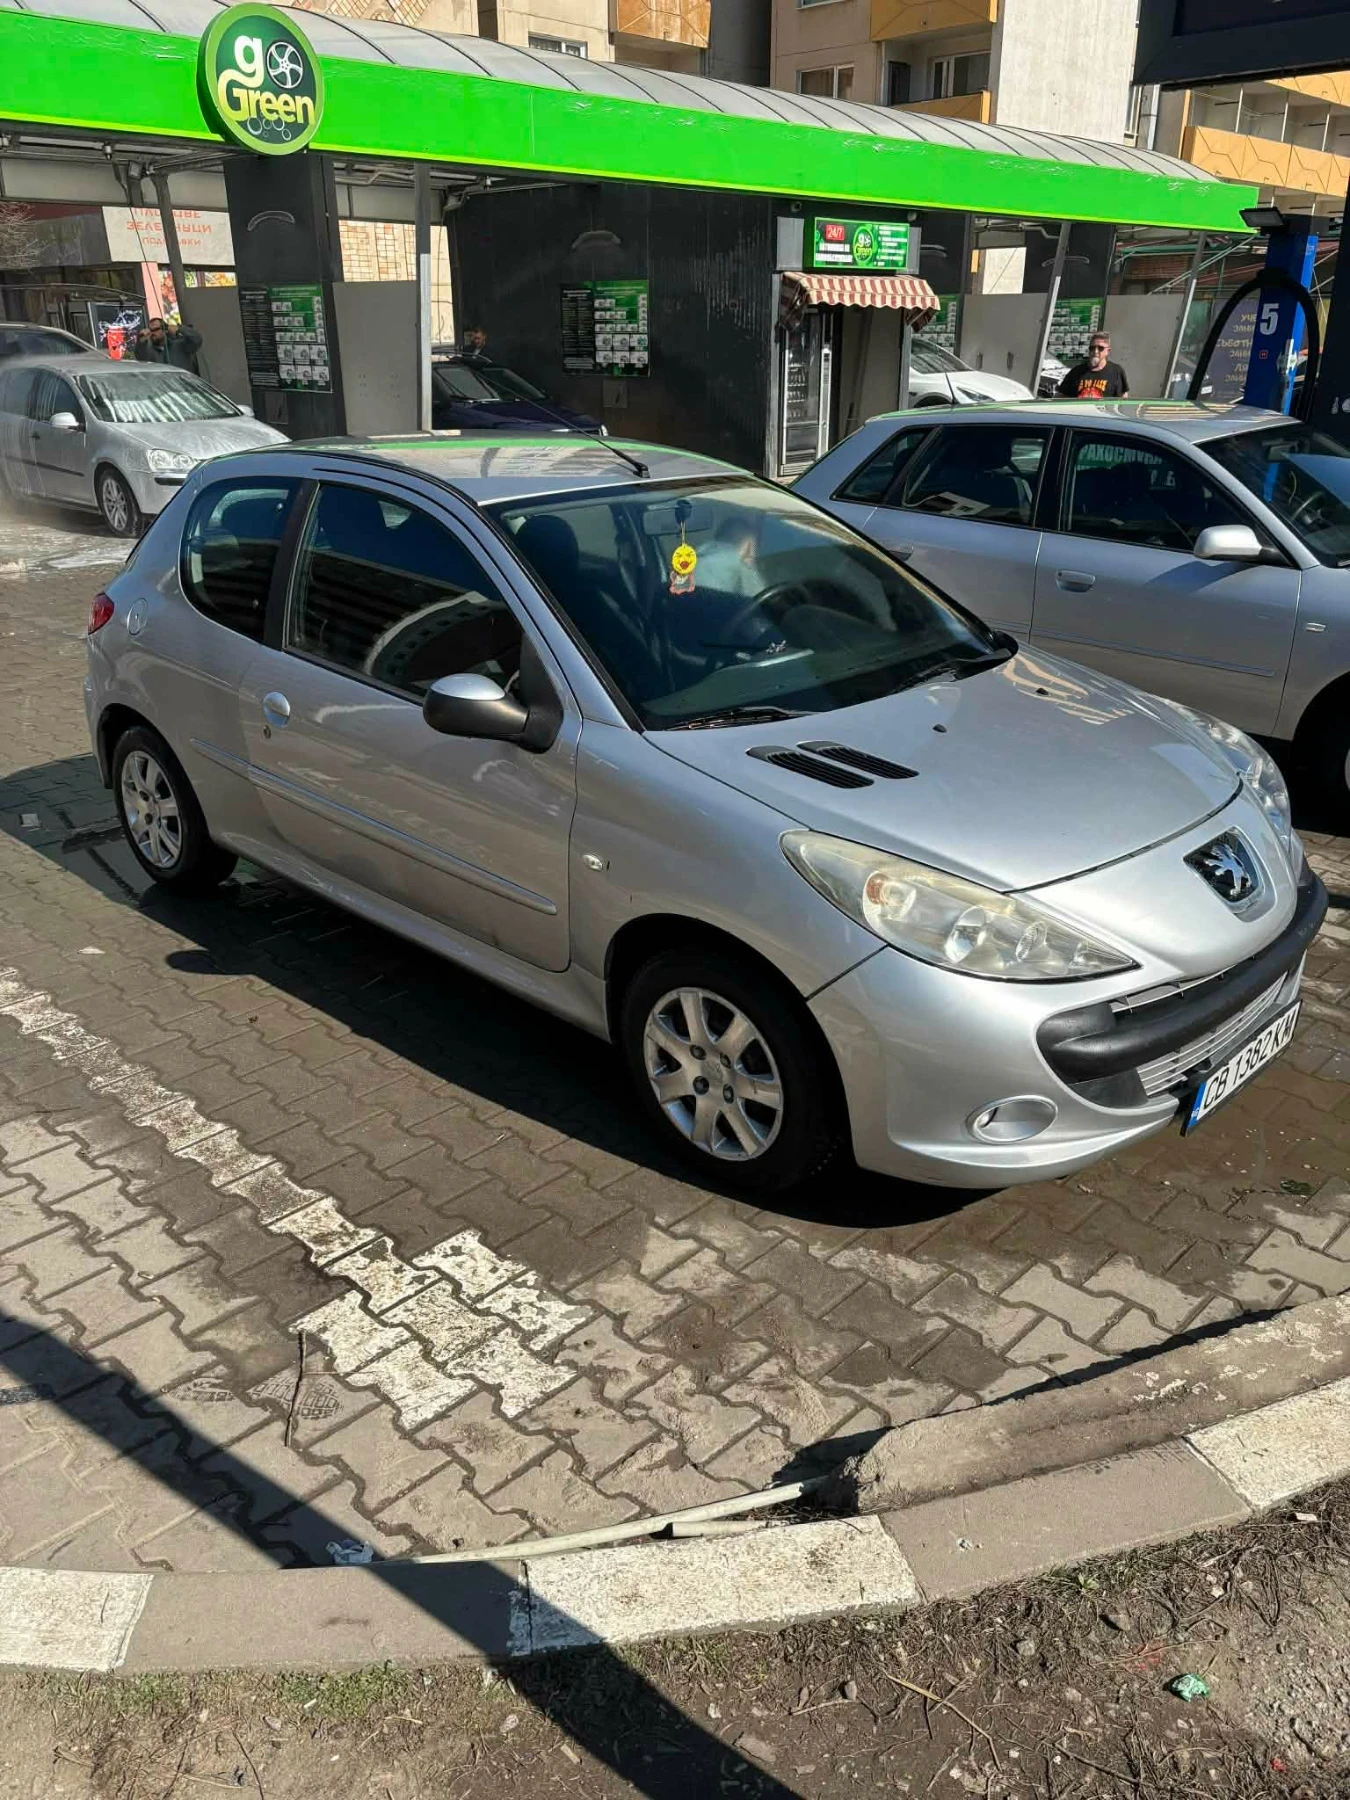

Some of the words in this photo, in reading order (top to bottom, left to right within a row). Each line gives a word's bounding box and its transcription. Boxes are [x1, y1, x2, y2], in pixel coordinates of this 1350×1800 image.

[217, 69, 316, 124] Green
[828, 226, 843, 238] 24/7
[1260, 303, 1279, 335] 5
[1204, 1067, 1229, 1109] CB
[1233, 1030, 1272, 1085] 1382
